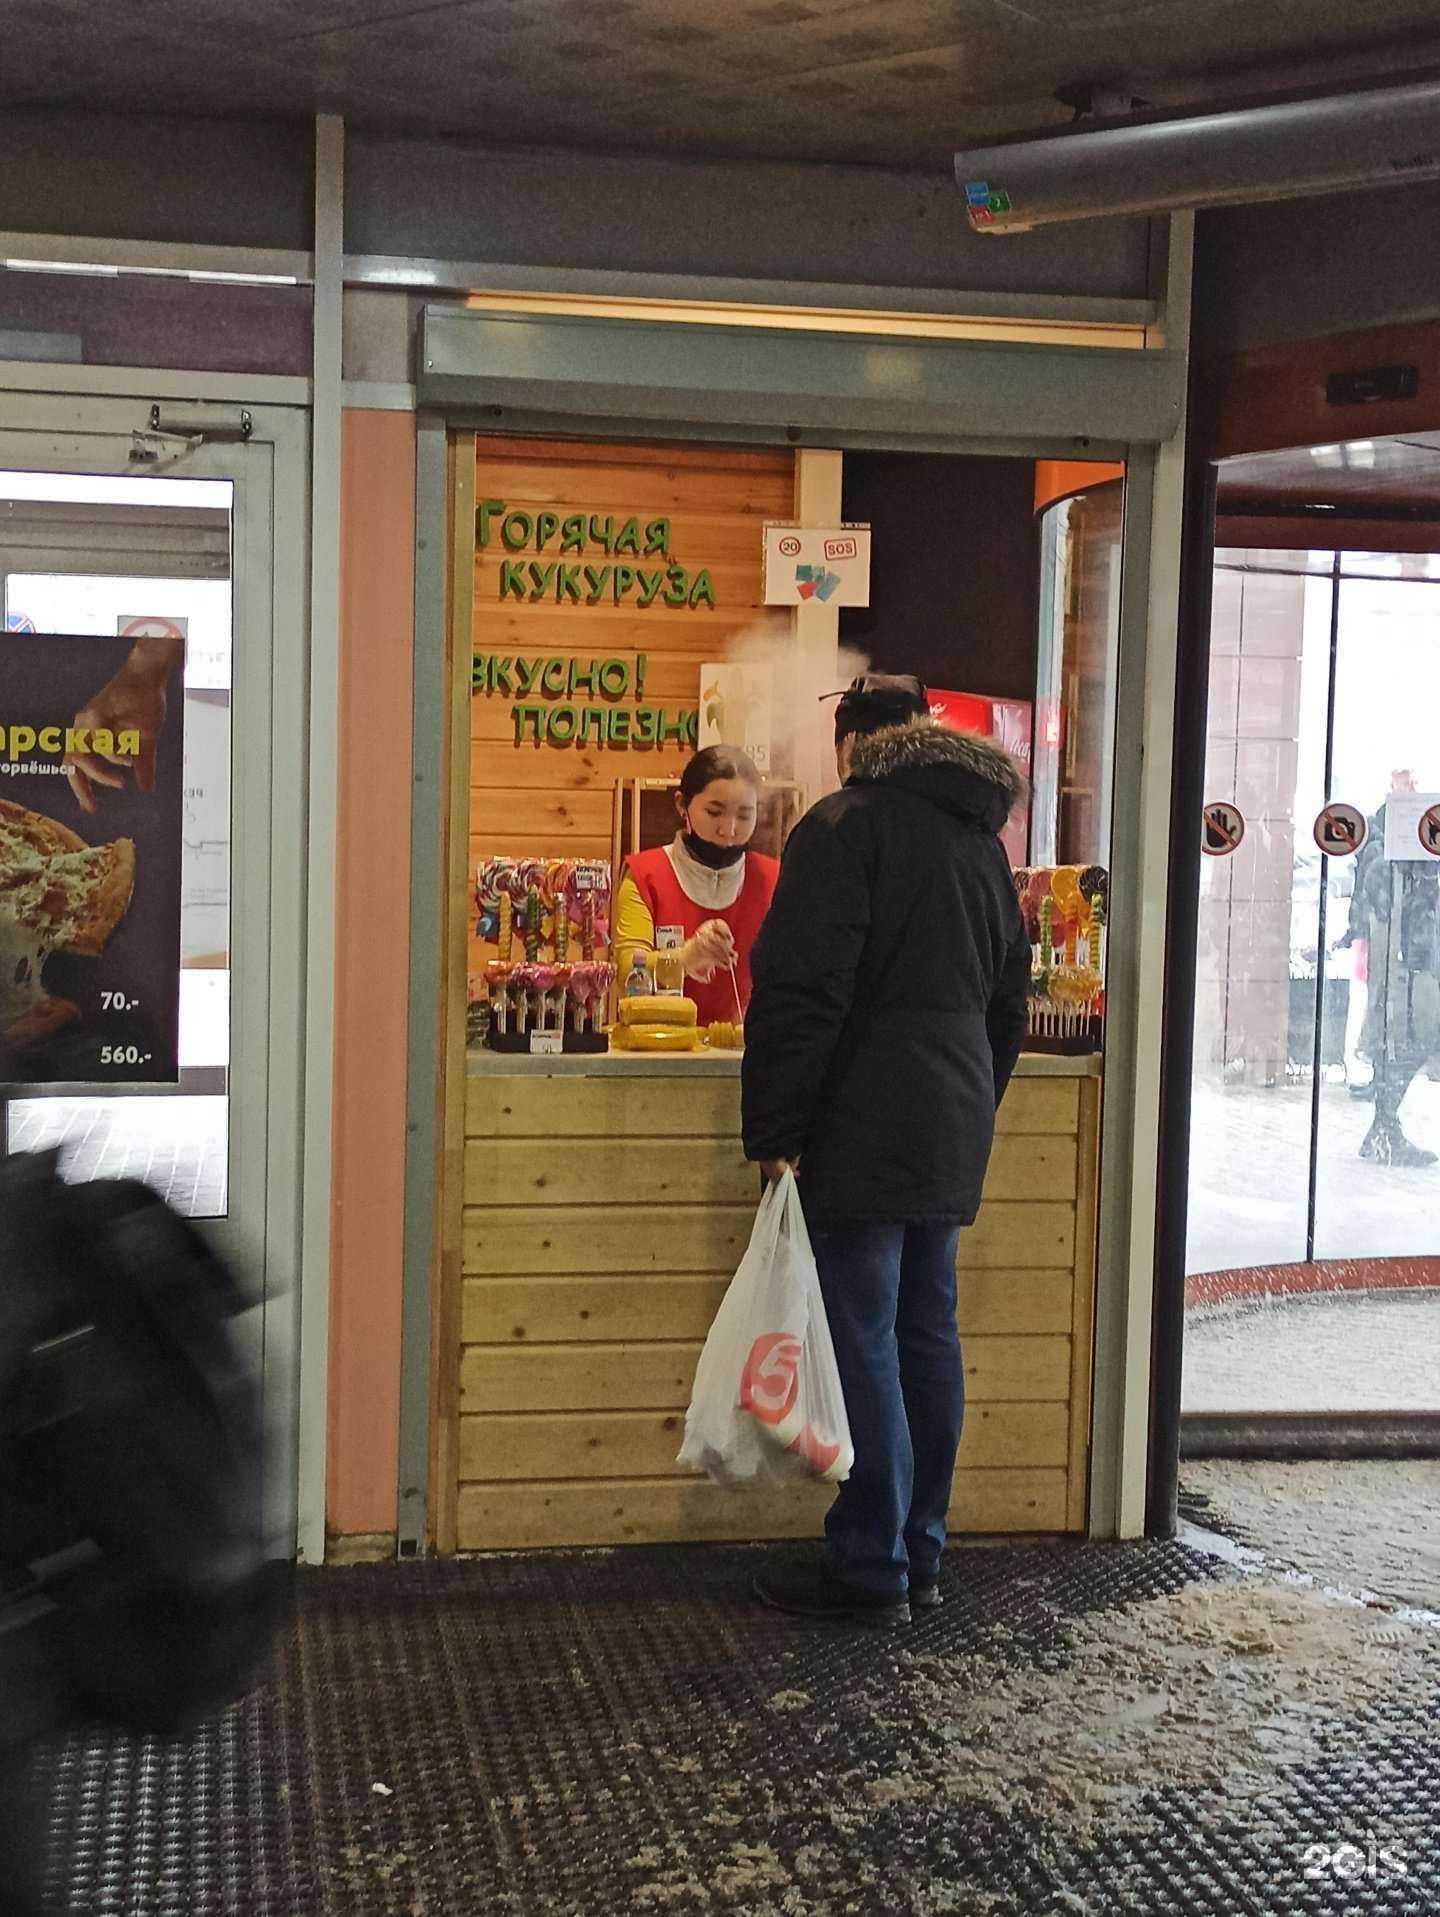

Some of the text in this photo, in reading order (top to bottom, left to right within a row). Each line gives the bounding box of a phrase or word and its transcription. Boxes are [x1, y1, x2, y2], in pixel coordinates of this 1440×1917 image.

[783, 541, 798, 552] 20
[827, 542, 854, 556] SOS
[500, 559, 715, 610] КУКУРУЗА
[0, 725, 140, 761] рская
[0, 761, 76, 776] орвёшься
[101, 991, 139, 1011] 70.-
[100, 1045, 152, 1064] 560.-
